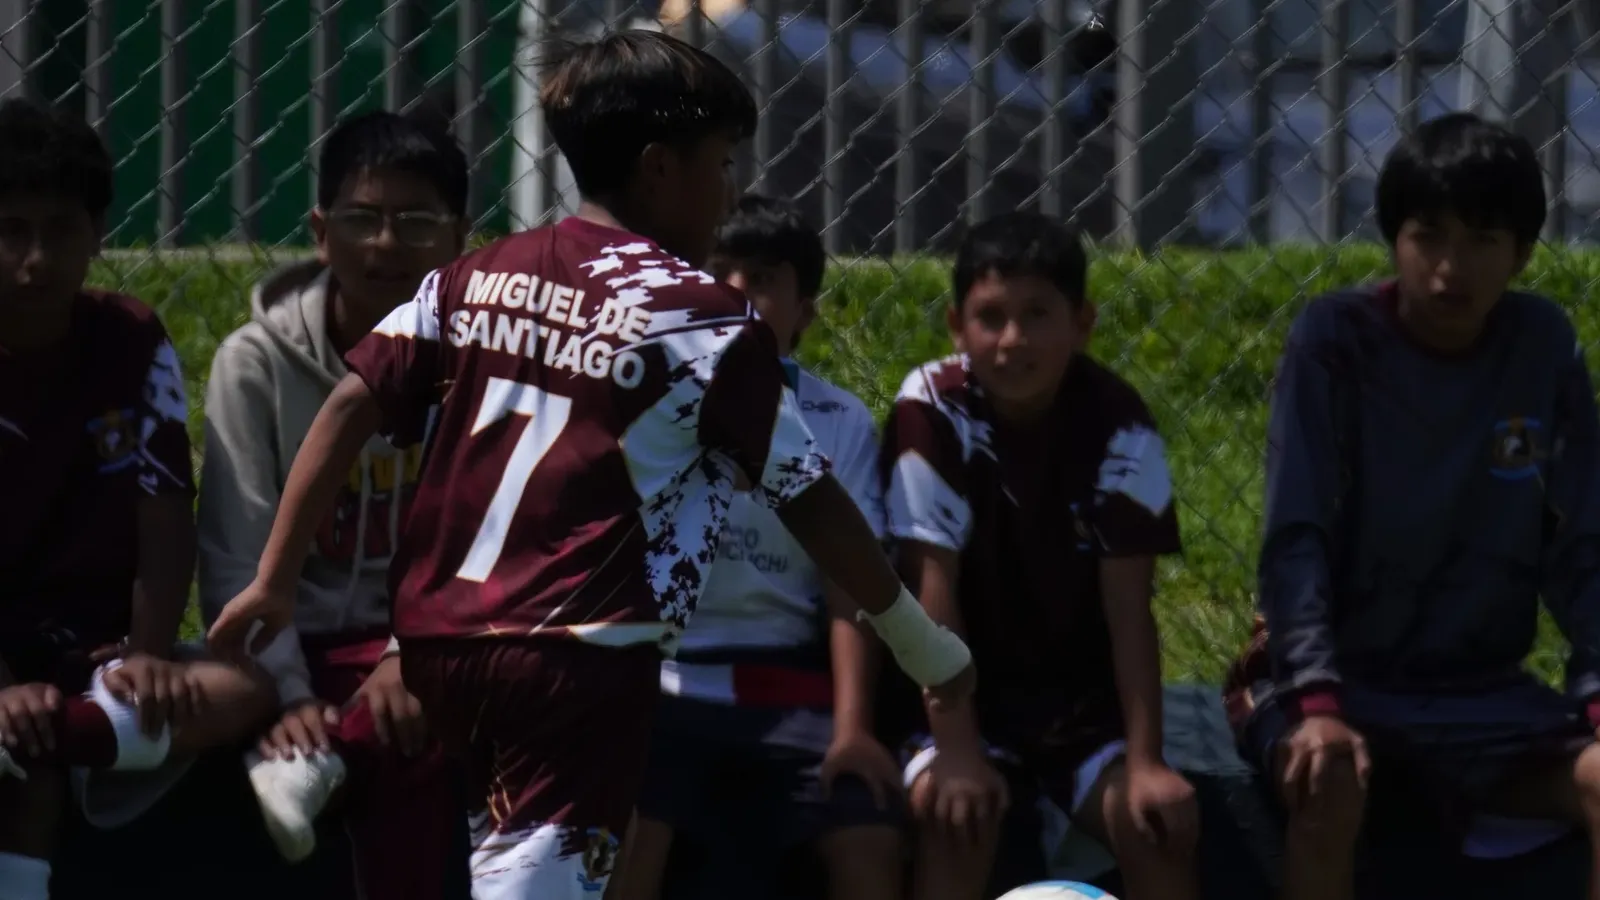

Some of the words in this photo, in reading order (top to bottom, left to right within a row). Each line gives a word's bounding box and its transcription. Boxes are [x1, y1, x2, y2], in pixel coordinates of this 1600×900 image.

[463, 269, 588, 329] MIGUEL
[596, 296, 652, 343] DE
[448, 309, 646, 389] SANTIAGO
[456, 376, 573, 583] 7
